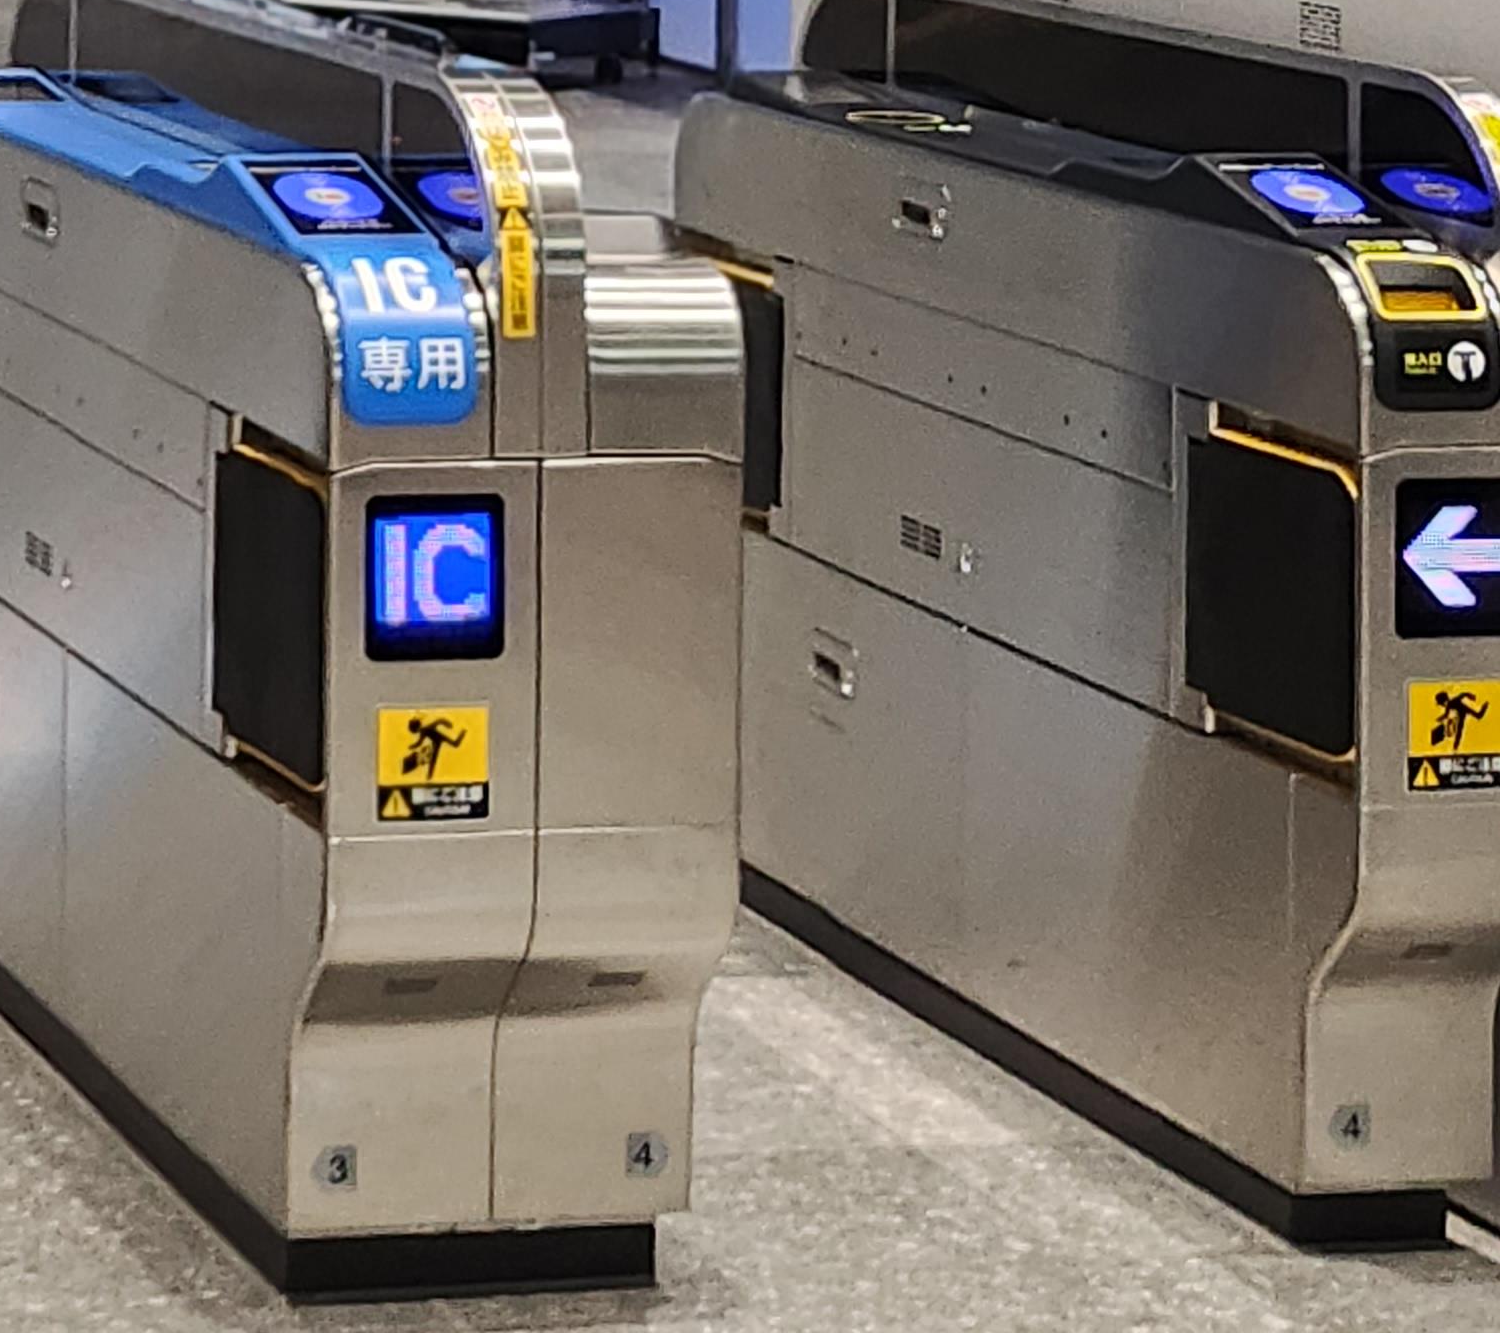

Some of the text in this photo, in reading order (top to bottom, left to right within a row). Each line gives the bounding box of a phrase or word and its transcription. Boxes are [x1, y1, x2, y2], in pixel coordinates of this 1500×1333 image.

[351, 256, 439, 315] IC
[357, 337, 465, 393] 専用
[384, 523, 486, 625] IC
[1341, 1111, 1362, 1140] 4
[327, 1153, 349, 1184] 3
[632, 1141, 655, 1169] 4
